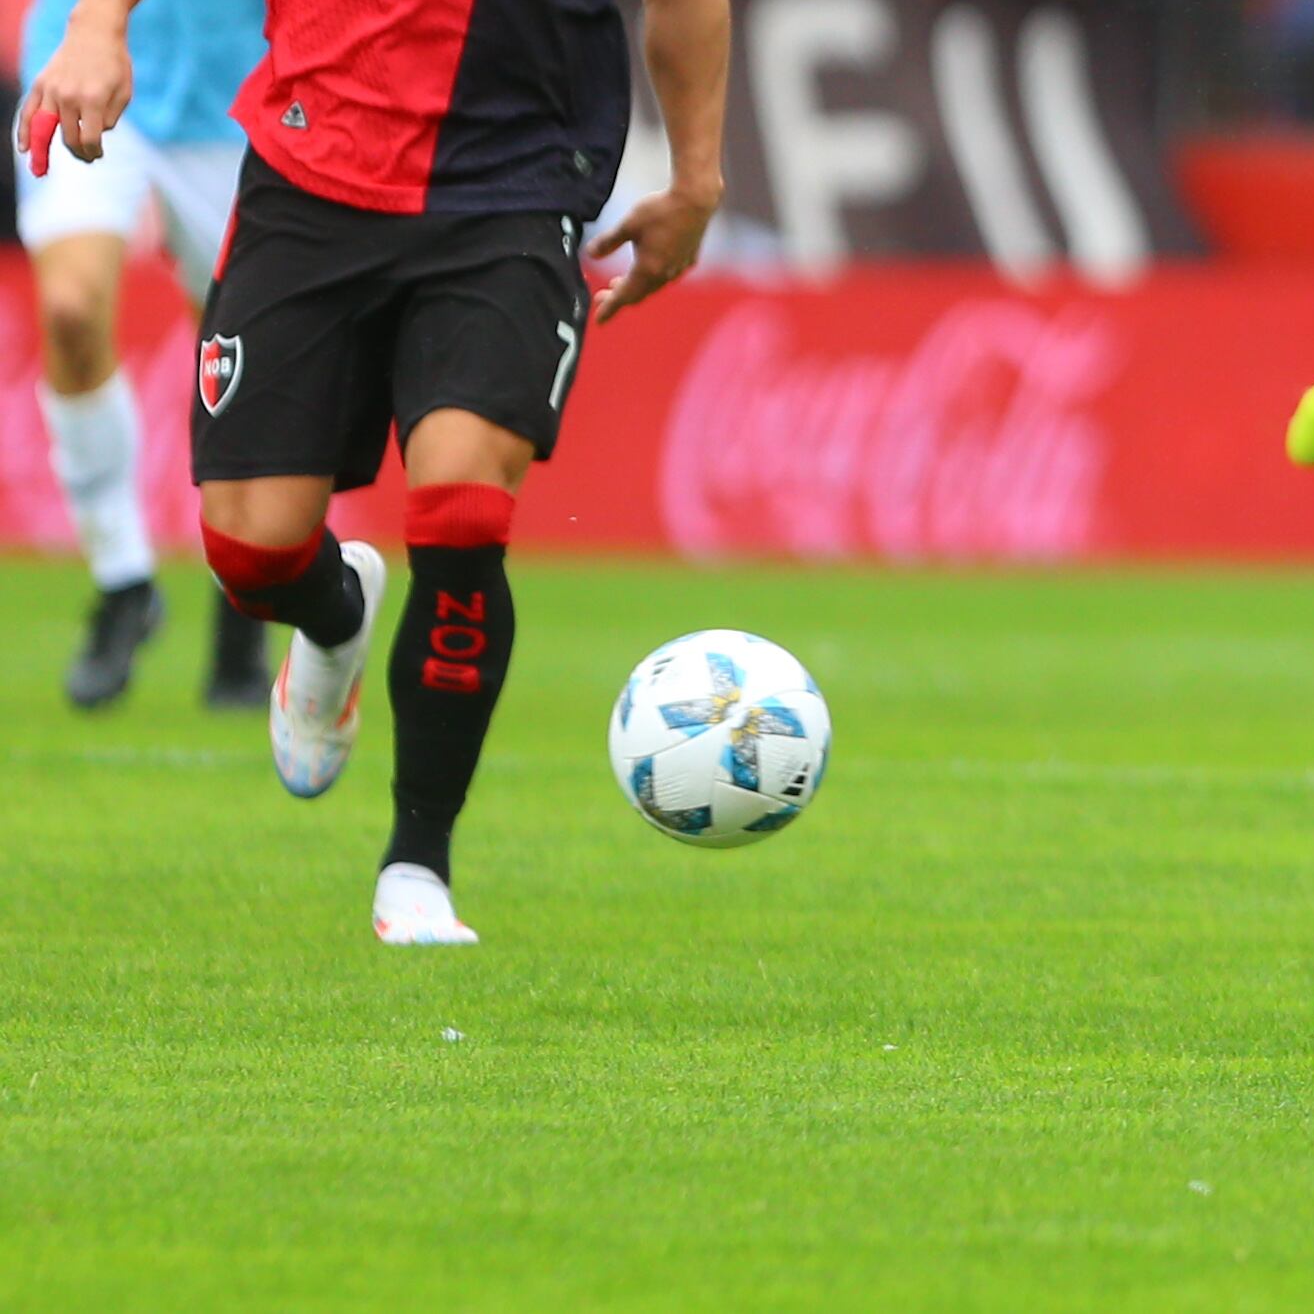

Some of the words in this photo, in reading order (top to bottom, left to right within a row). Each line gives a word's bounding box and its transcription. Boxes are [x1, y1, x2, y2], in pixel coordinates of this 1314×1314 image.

[204, 355, 233, 379] NOB
[548, 319, 577, 412] 7
[422, 589, 487, 694] NOB
